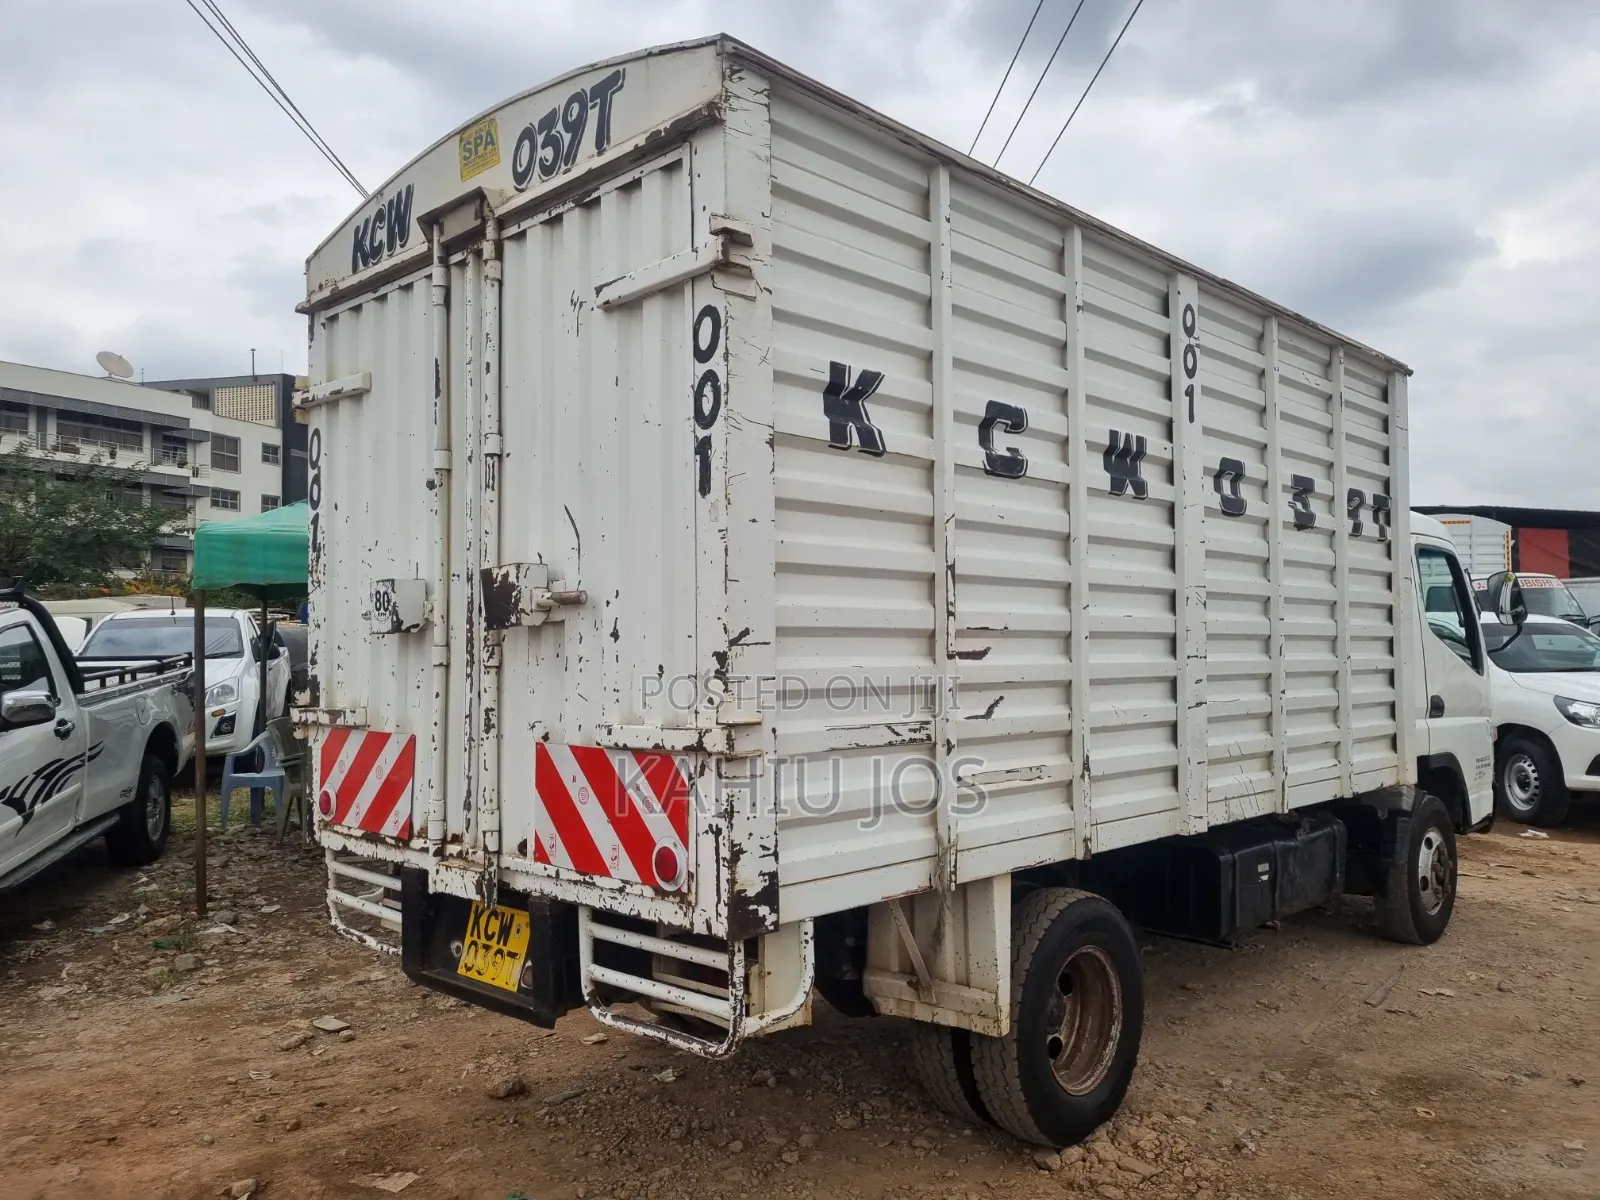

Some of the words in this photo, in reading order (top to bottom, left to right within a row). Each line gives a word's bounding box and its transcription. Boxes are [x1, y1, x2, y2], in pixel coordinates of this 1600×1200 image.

[463, 129, 496, 161] SPA
[512, 68, 626, 193] 039T
[352, 183, 414, 274] KCW
[1183, 303, 1198, 424] 001
[694, 304, 722, 499] 001
[309, 428, 322, 553] 001
[375, 590, 390, 612] 80
[1520, 579, 1554, 588] UBISHI
[469, 904, 515, 947] KCW
[464, 940, 521, 987] 039T
